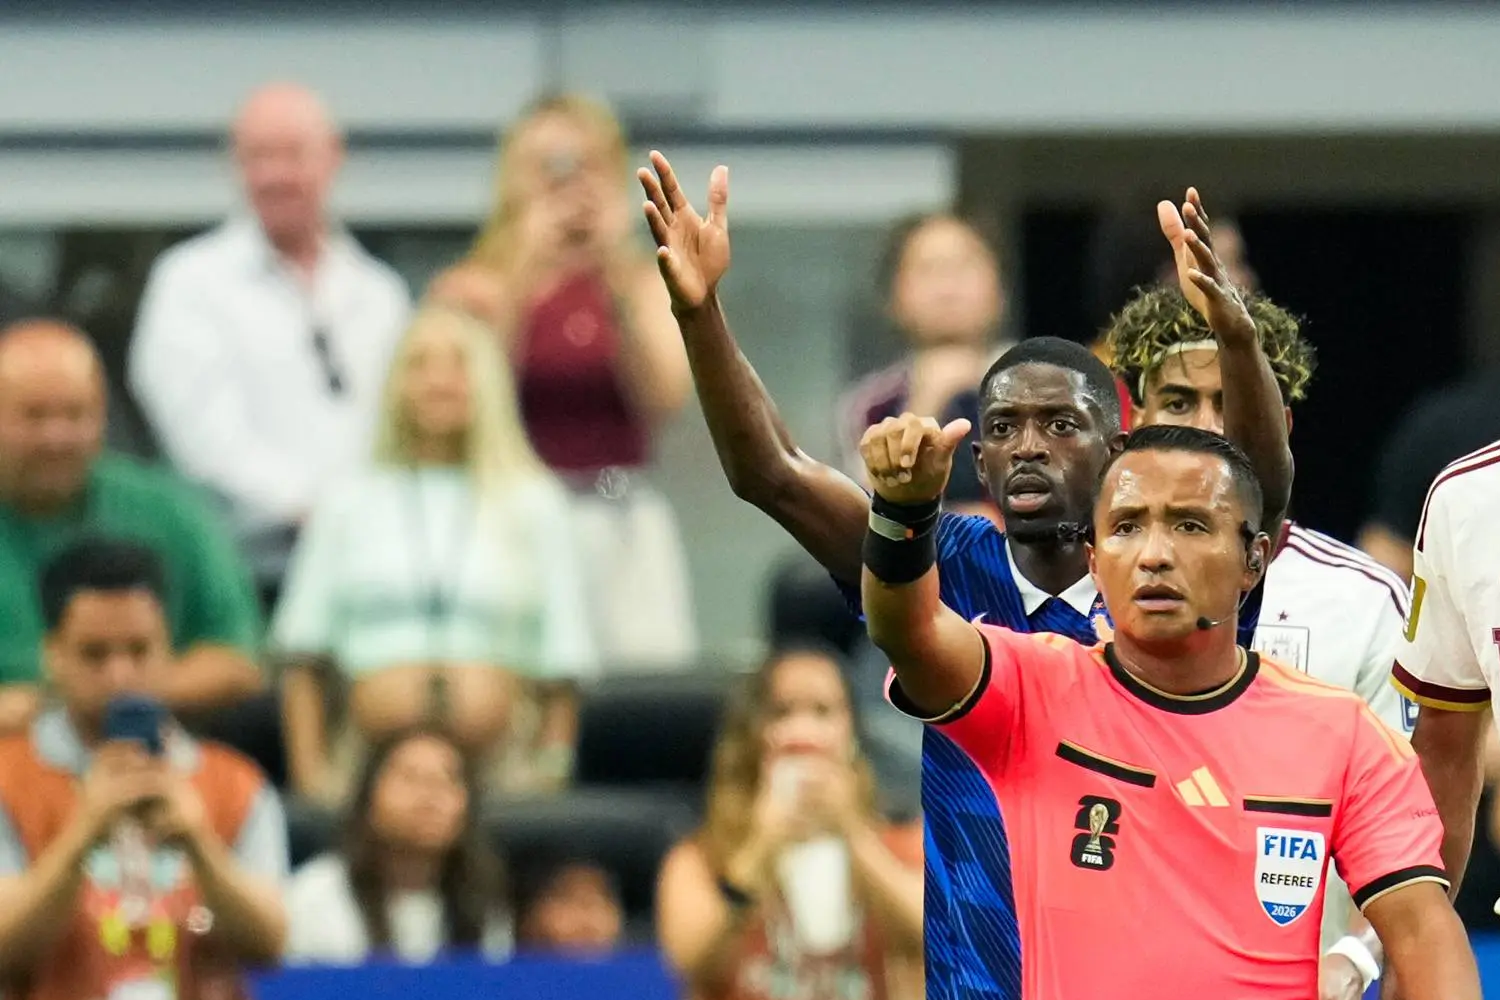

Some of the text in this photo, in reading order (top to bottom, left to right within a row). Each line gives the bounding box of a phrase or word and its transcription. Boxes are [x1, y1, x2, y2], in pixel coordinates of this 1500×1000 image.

[1264, 834, 1318, 861] FIFA
[1081, 853, 1103, 866] FIFA
[1260, 872, 1314, 888] REFEREE
[1271, 905, 1297, 918] 2026
